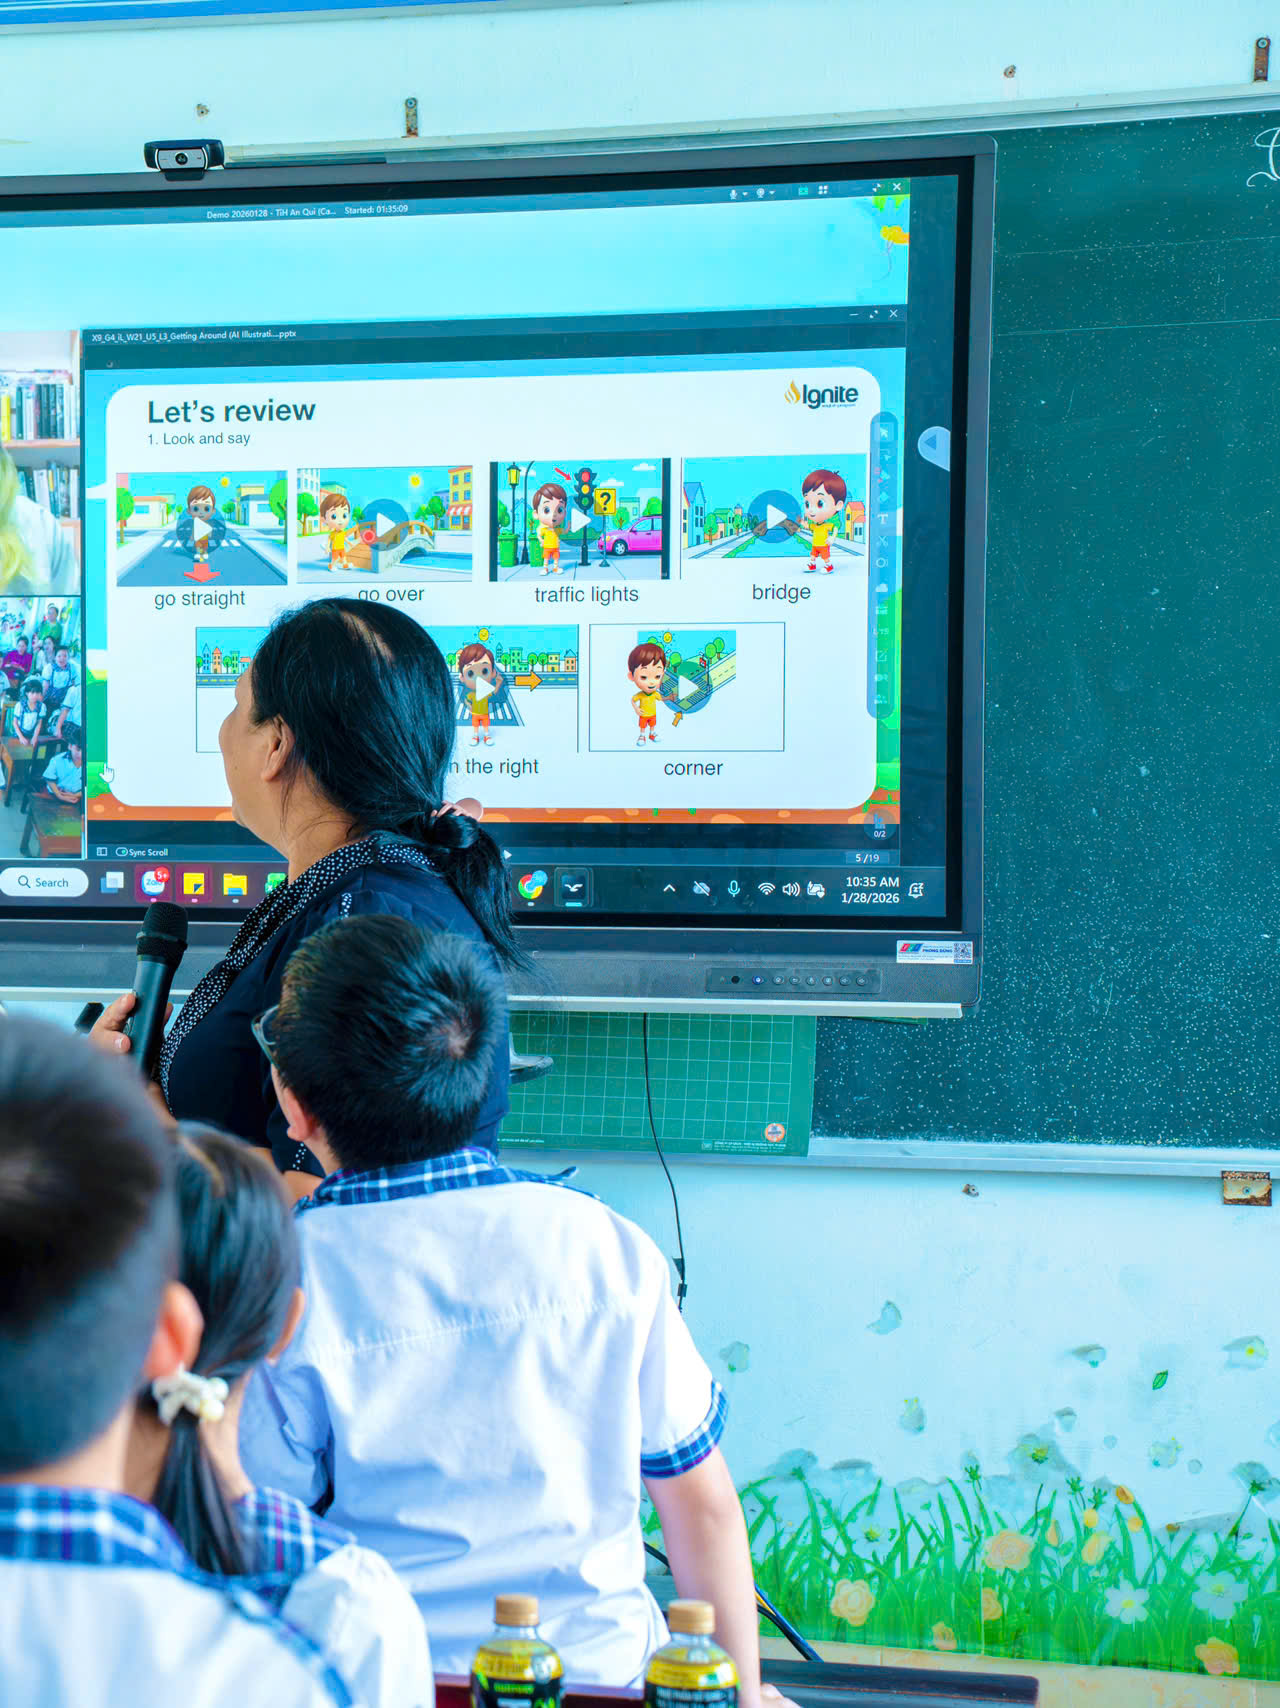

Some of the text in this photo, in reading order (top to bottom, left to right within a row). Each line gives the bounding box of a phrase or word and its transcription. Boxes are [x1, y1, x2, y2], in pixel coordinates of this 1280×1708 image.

[206, 210, 229, 219] Demo
[231, 209, 268, 218] 20260128
[289, 208, 301, 216] An
[376, 204, 409, 214] 01:35:09
[199, 331, 227, 340] Around
[802, 383, 859, 410] Ignite
[224, 399, 317, 423] review
[148, 432, 251, 447] 1. Look and say
[154, 590, 246, 610] go straight
[385, 588, 425, 602] over
[534, 584, 640, 607] traffic lights
[752, 583, 812, 604] bridge
[465, 757, 493, 774] the
[499, 757, 540, 779] right
[664, 763, 724, 776] corner
[873, 830, 887, 839] 0/2
[128, 848, 169, 857] Sync Scroll
[35, 876, 69, 889] Search
[846, 876, 900, 888] 10:35 AM
[841, 891, 900, 904] 1/28/2026
